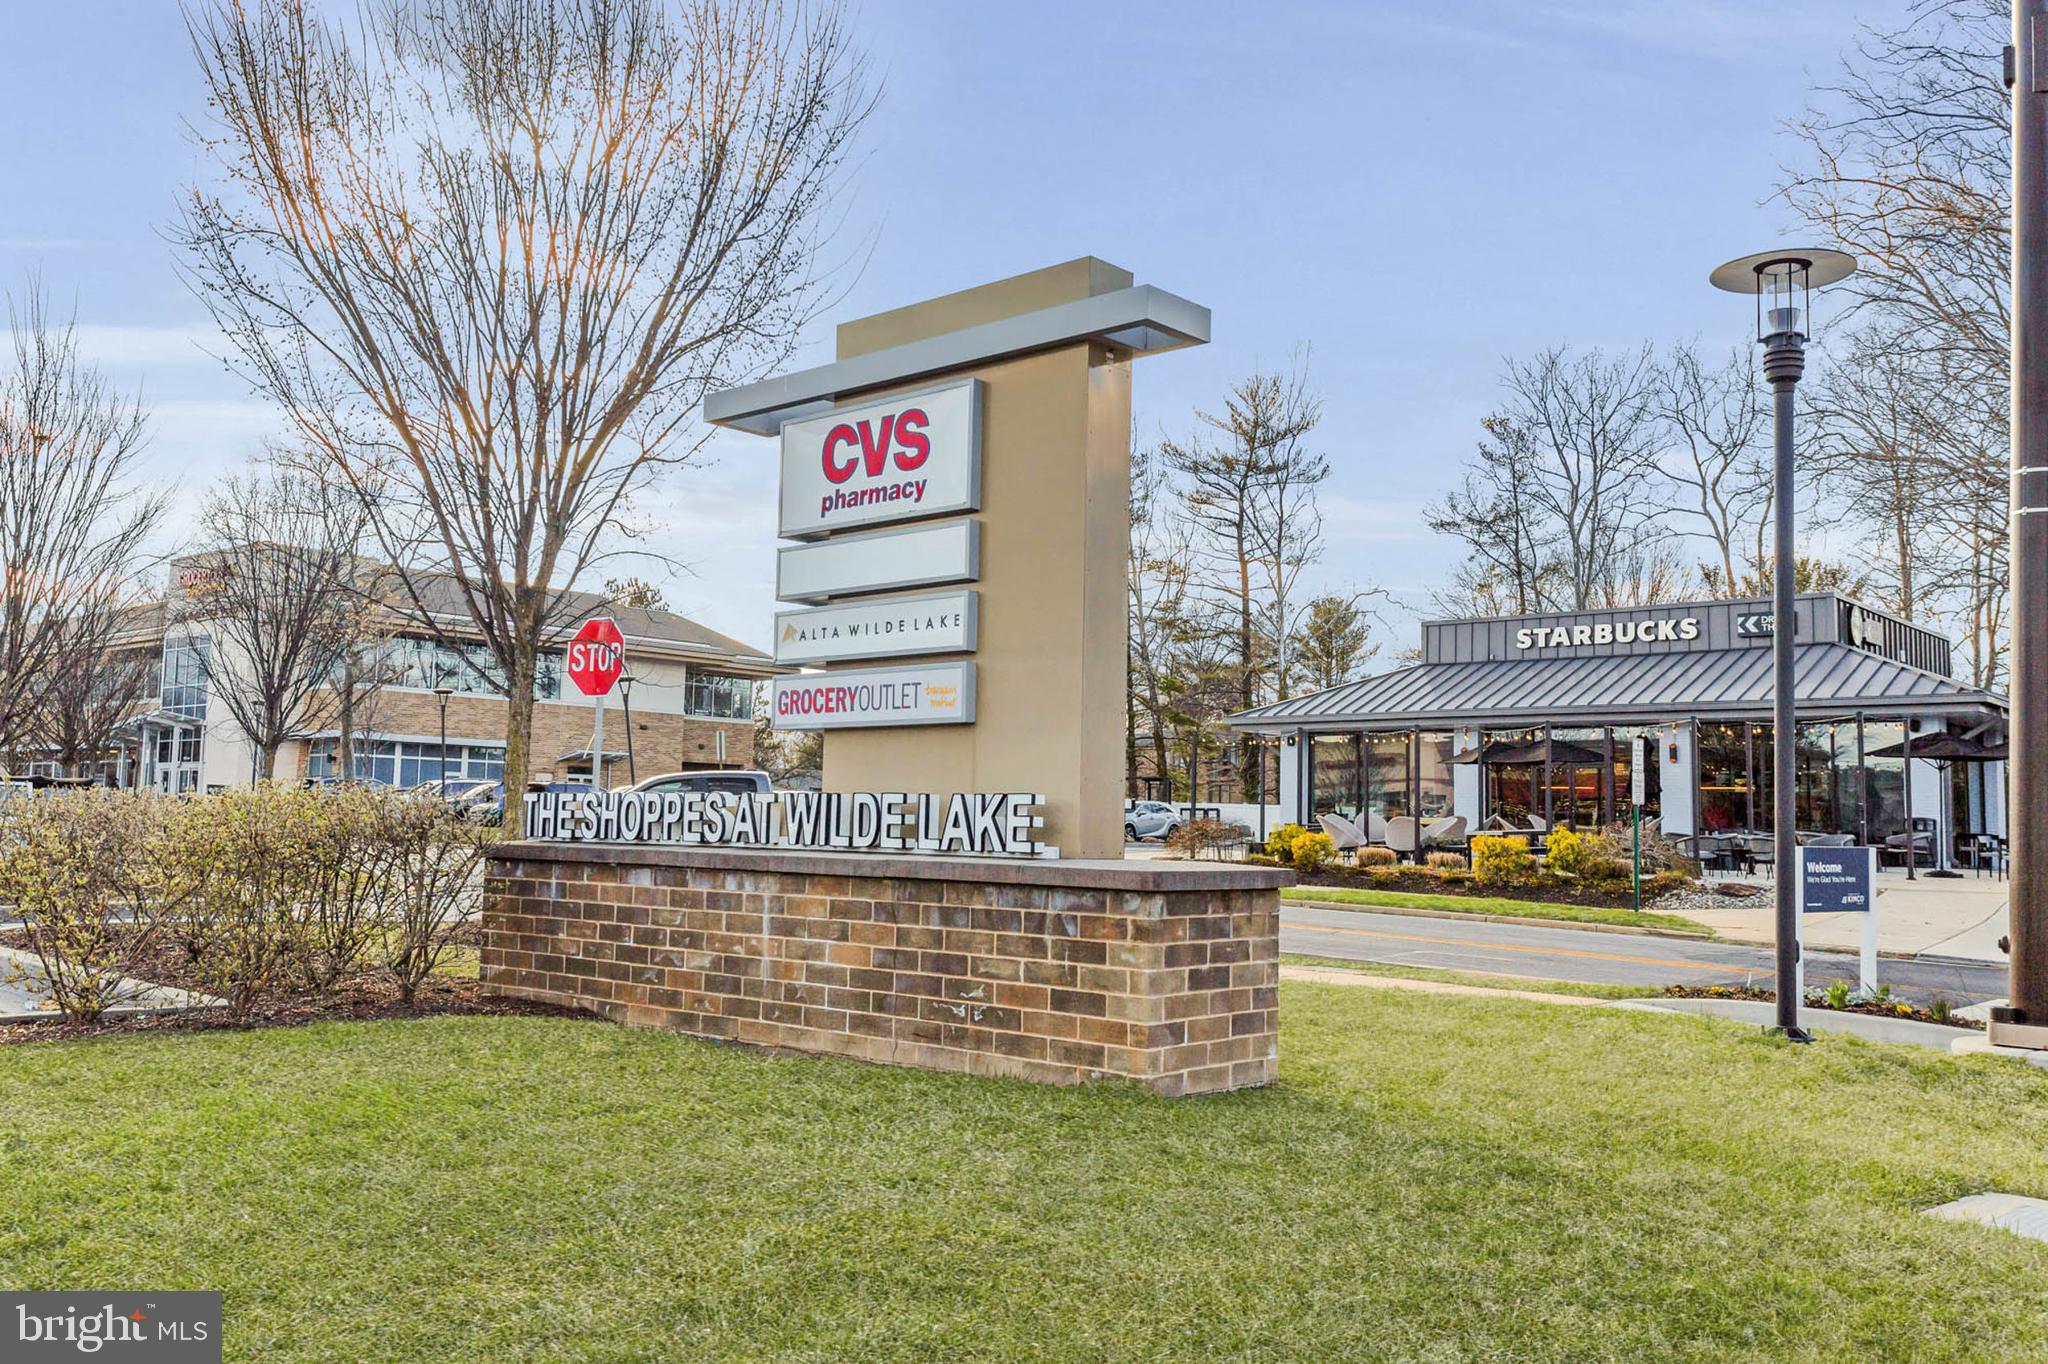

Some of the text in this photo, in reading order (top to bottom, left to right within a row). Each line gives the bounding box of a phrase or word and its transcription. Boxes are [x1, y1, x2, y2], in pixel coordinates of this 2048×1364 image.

[822, 408, 931, 484] CVS
[821, 479, 927, 518] pharmacy
[799, 613, 960, 641] ALTA WILDE LAKE
[1516, 617, 1698, 649] STARBUCKS
[571, 642, 621, 672] STOP
[523, 791, 1034, 855] THE SHOPPES AT WILDE LAKE
[1806, 861, 1842, 873] Welcome
